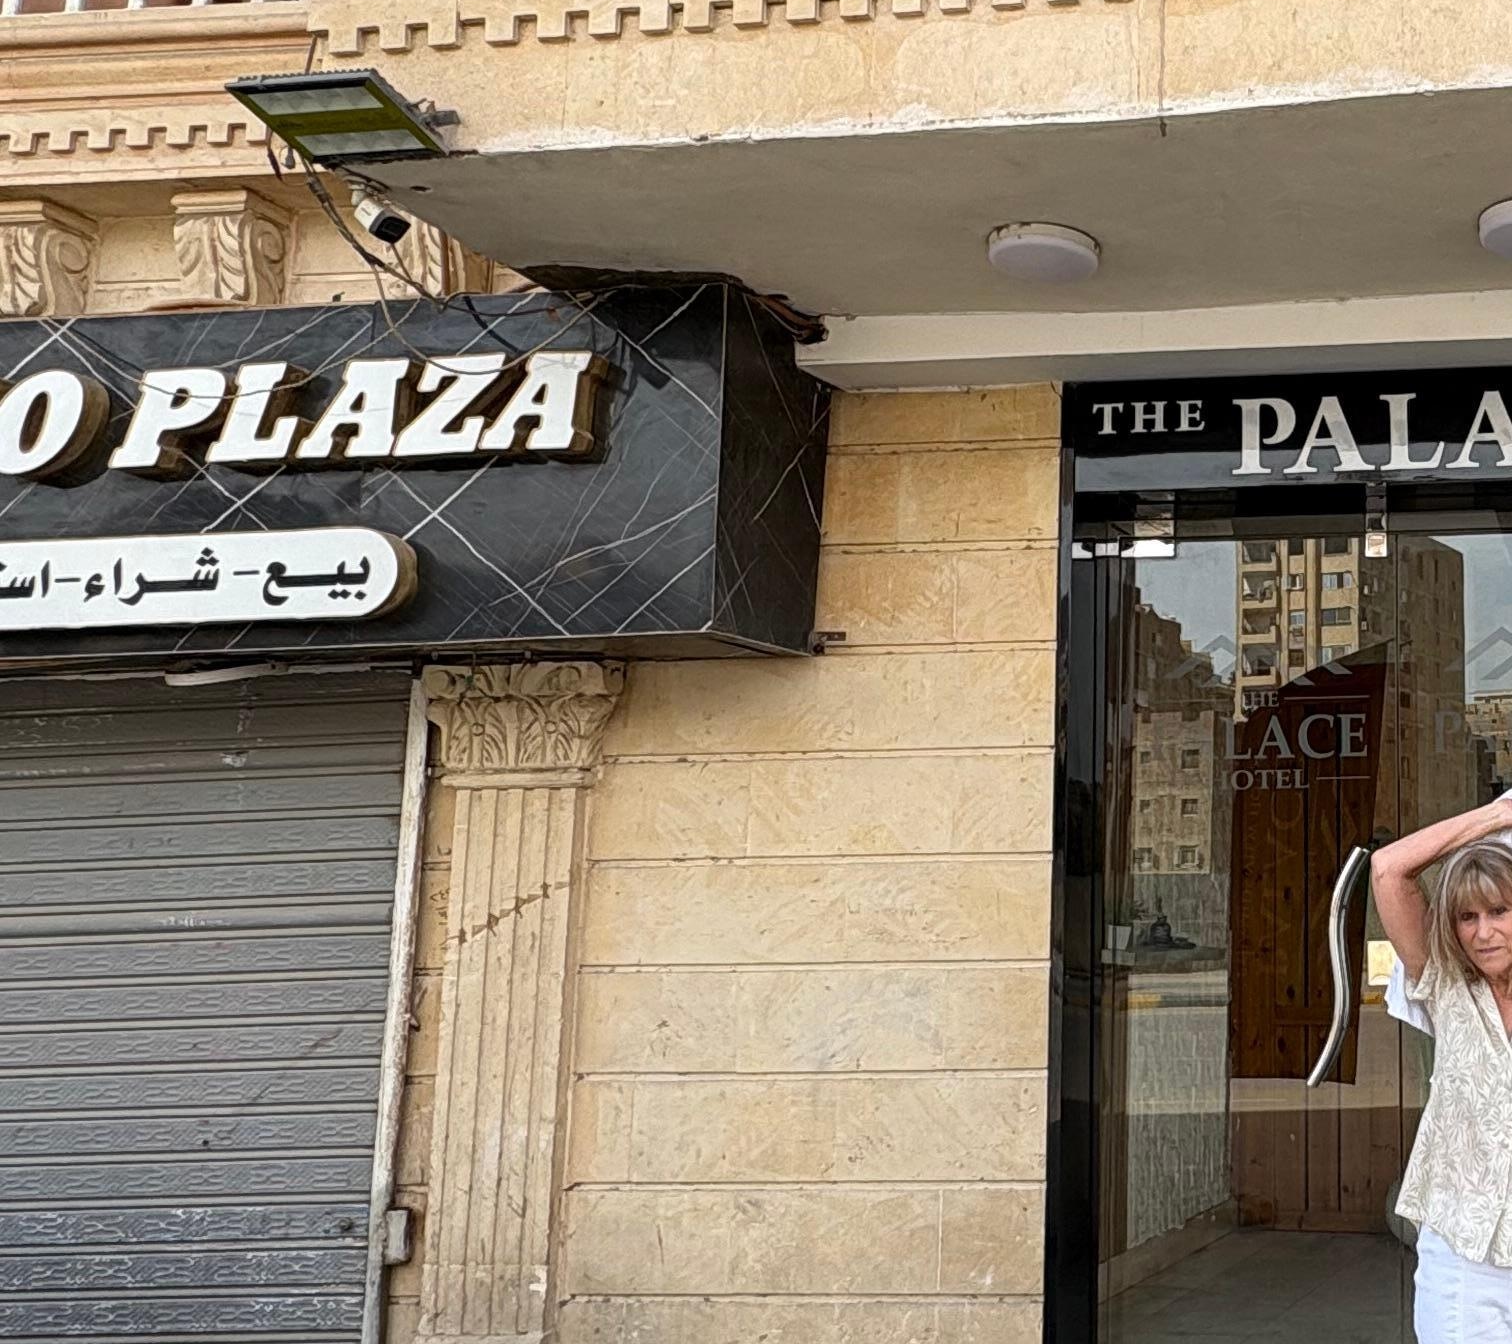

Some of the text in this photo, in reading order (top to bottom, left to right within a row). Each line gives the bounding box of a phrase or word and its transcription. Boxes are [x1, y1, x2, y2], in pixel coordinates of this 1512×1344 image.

[108, 350, 592, 470] PLAZA
[1092, 399, 1206, 435] THE
[1219, 712, 1369, 760] LACE
